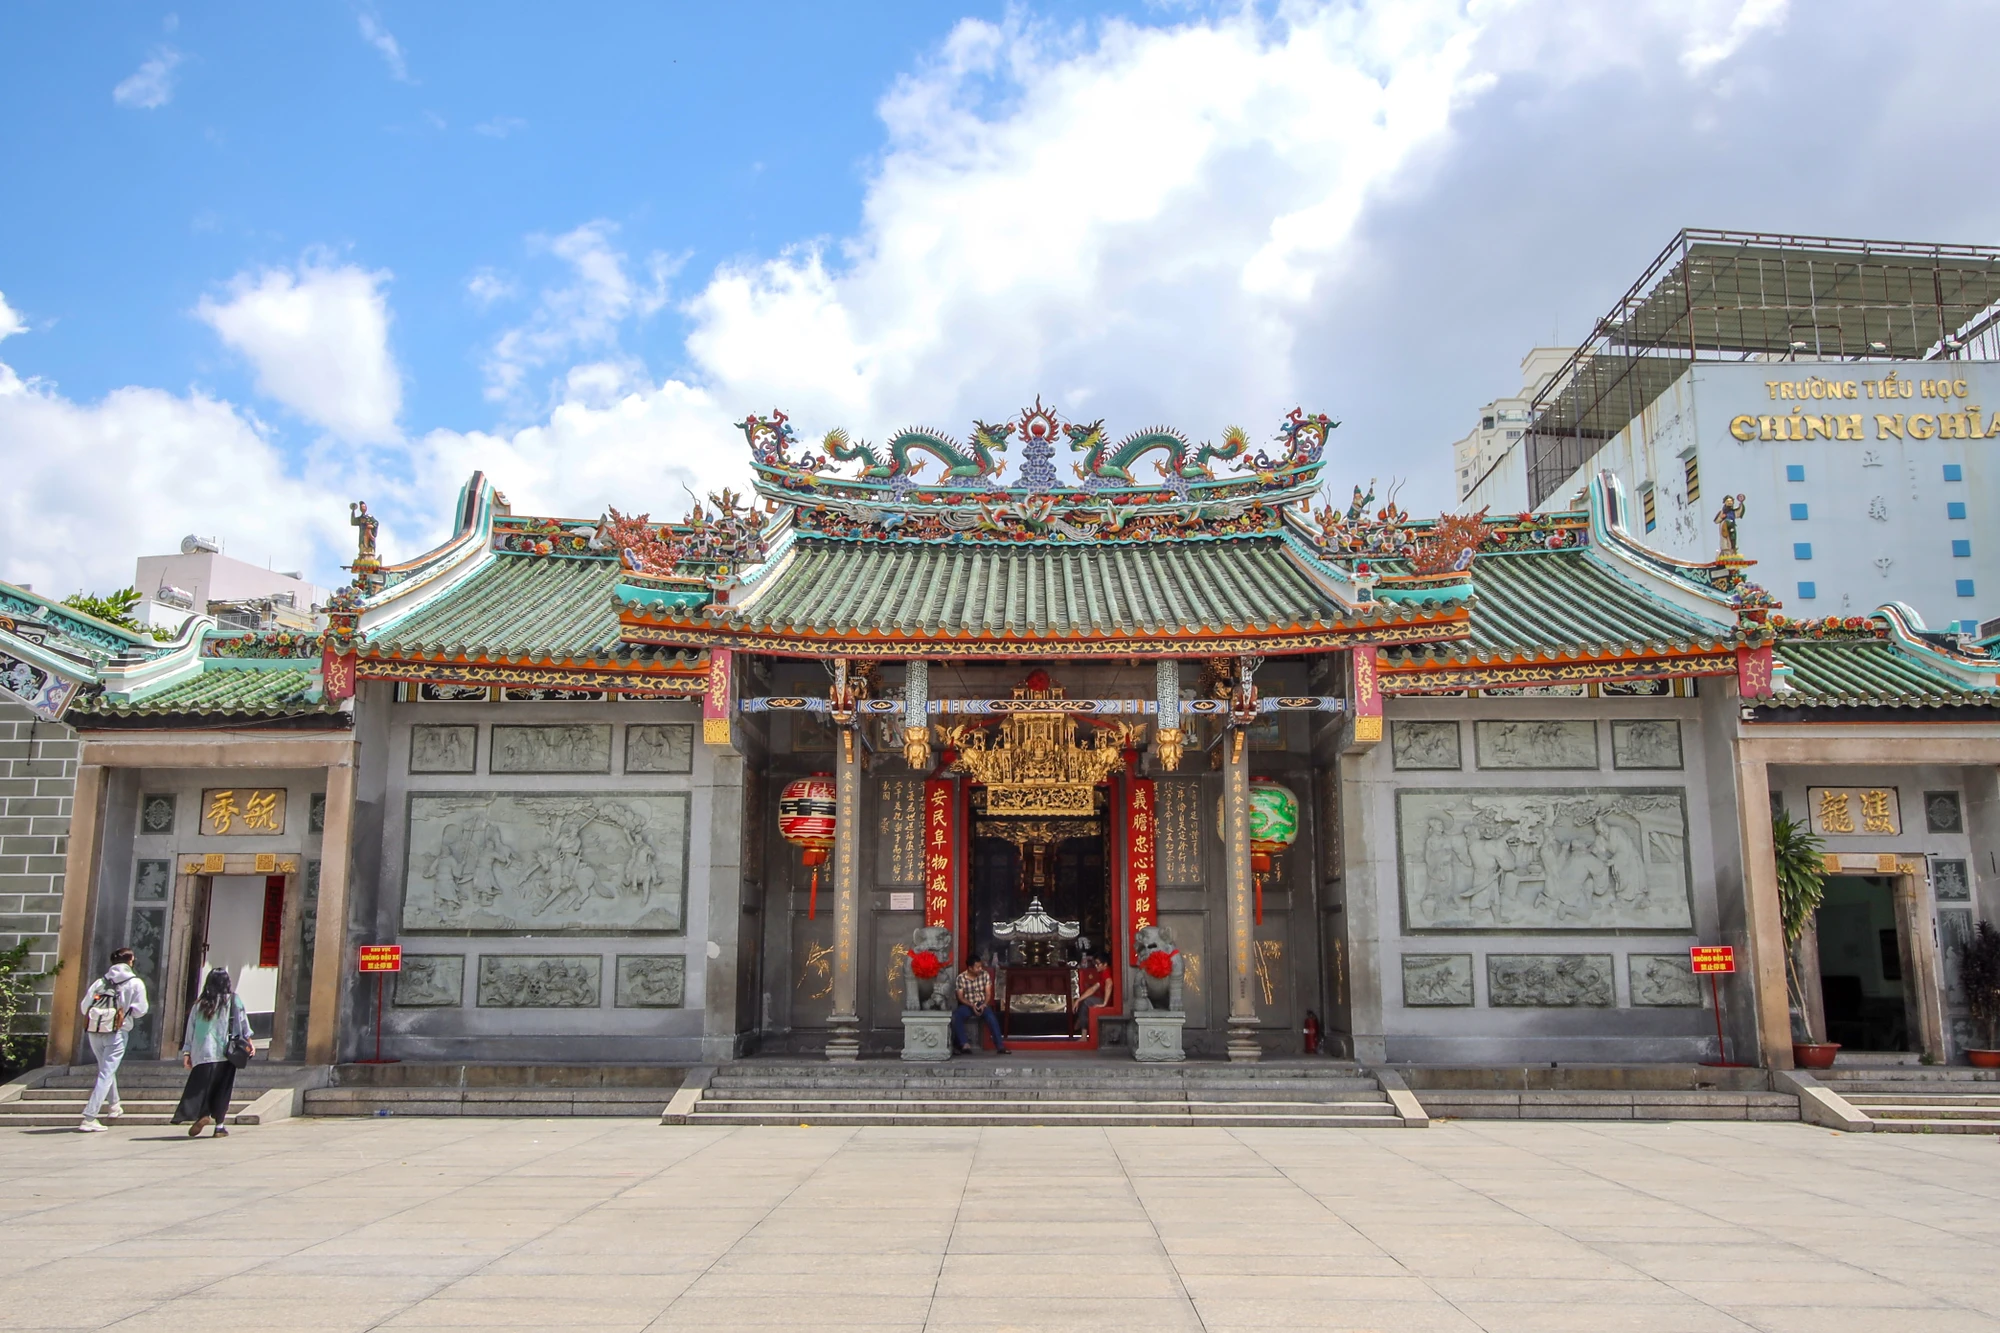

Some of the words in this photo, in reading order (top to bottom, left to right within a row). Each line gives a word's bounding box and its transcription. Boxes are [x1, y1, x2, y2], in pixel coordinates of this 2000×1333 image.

[1765, 376, 1858, 400] TRƯỜNG
[1863, 370, 1914, 399] TIỂU
[1920, 379, 1969, 403] HỌC
[1730, 405, 1865, 441] CHÍNH
